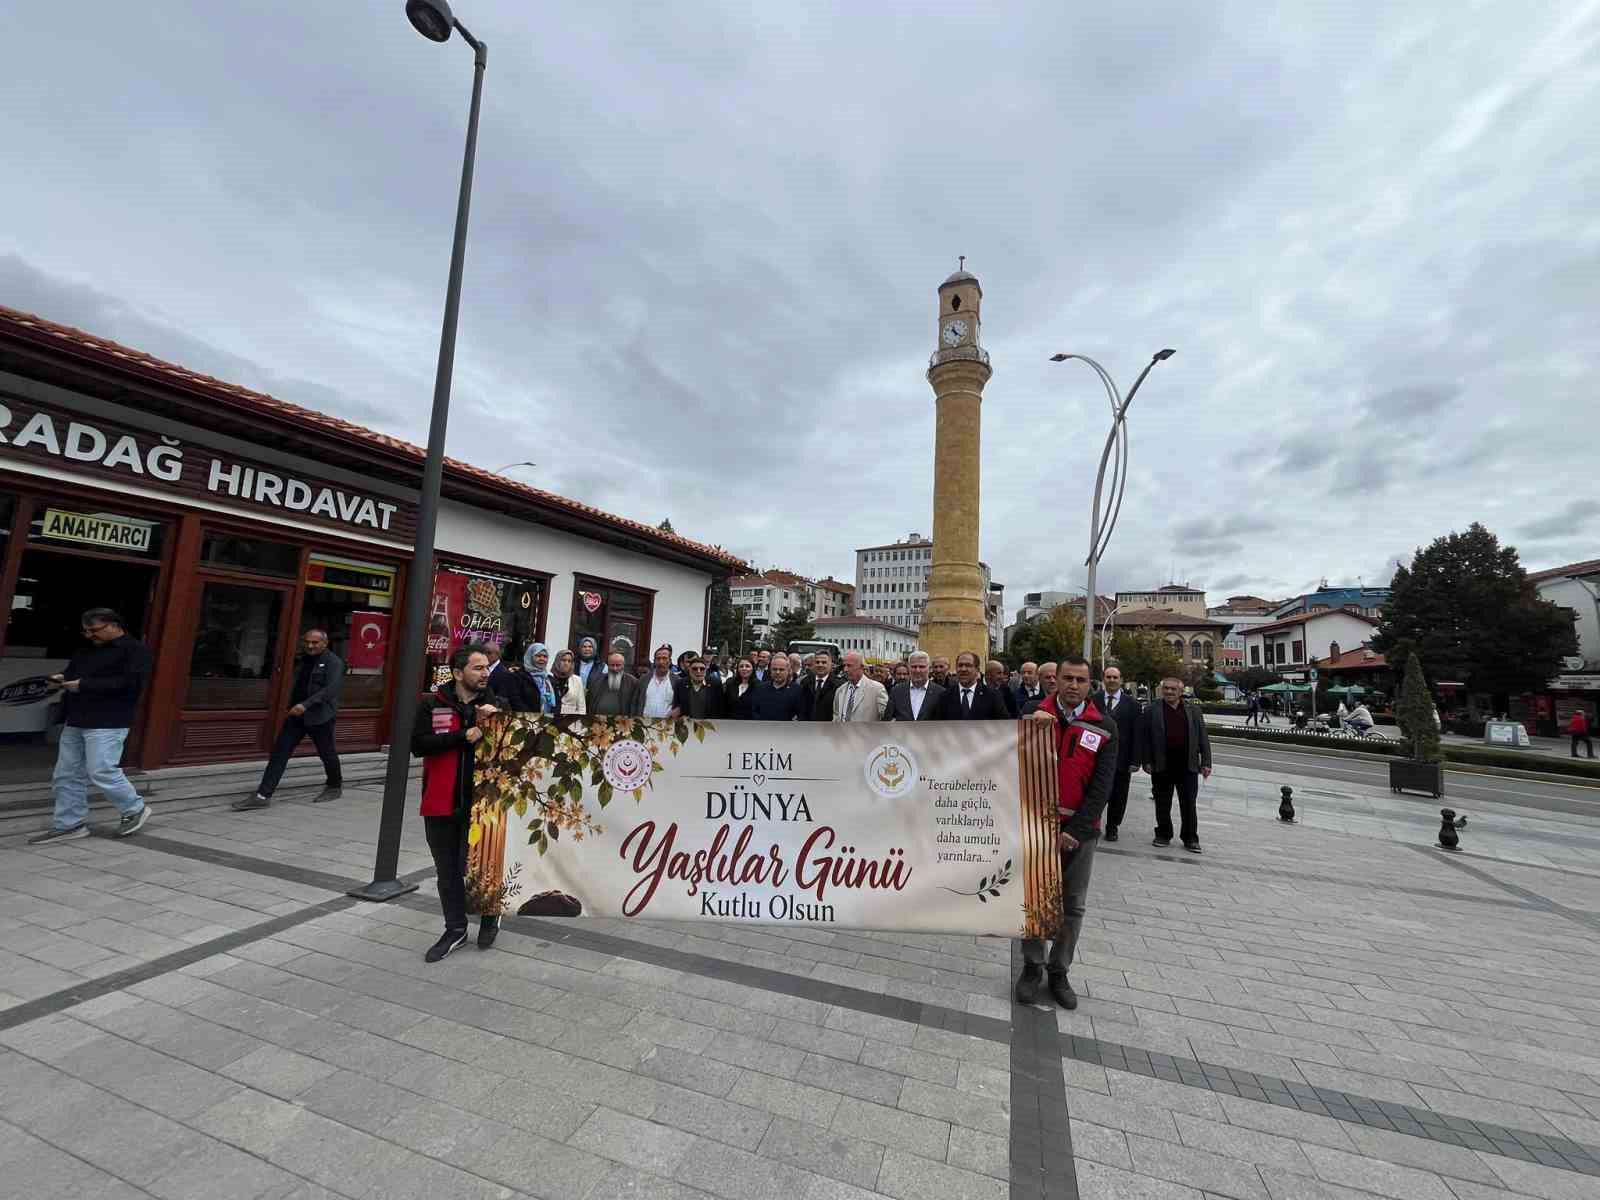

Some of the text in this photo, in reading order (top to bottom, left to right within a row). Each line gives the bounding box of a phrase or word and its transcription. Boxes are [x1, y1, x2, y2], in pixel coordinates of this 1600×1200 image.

[208, 459, 397, 530] HIRDAVAT
[48, 514, 147, 547] ANAHTARCI
[461, 614, 501, 631] OHAA
[454, 628, 504, 645] WAFFLE
[727, 748, 793, 771] 1 EKİM
[705, 785, 814, 822] DÜNYA
[935, 796, 991, 811] daha güçlü,
[936, 814, 994, 829] varlıklarıyla
[936, 832, 1000, 846] daha umutlu
[620, 821, 912, 917] Yaşlılar Günü
[700, 891, 835, 922] Kutlu Olsun
